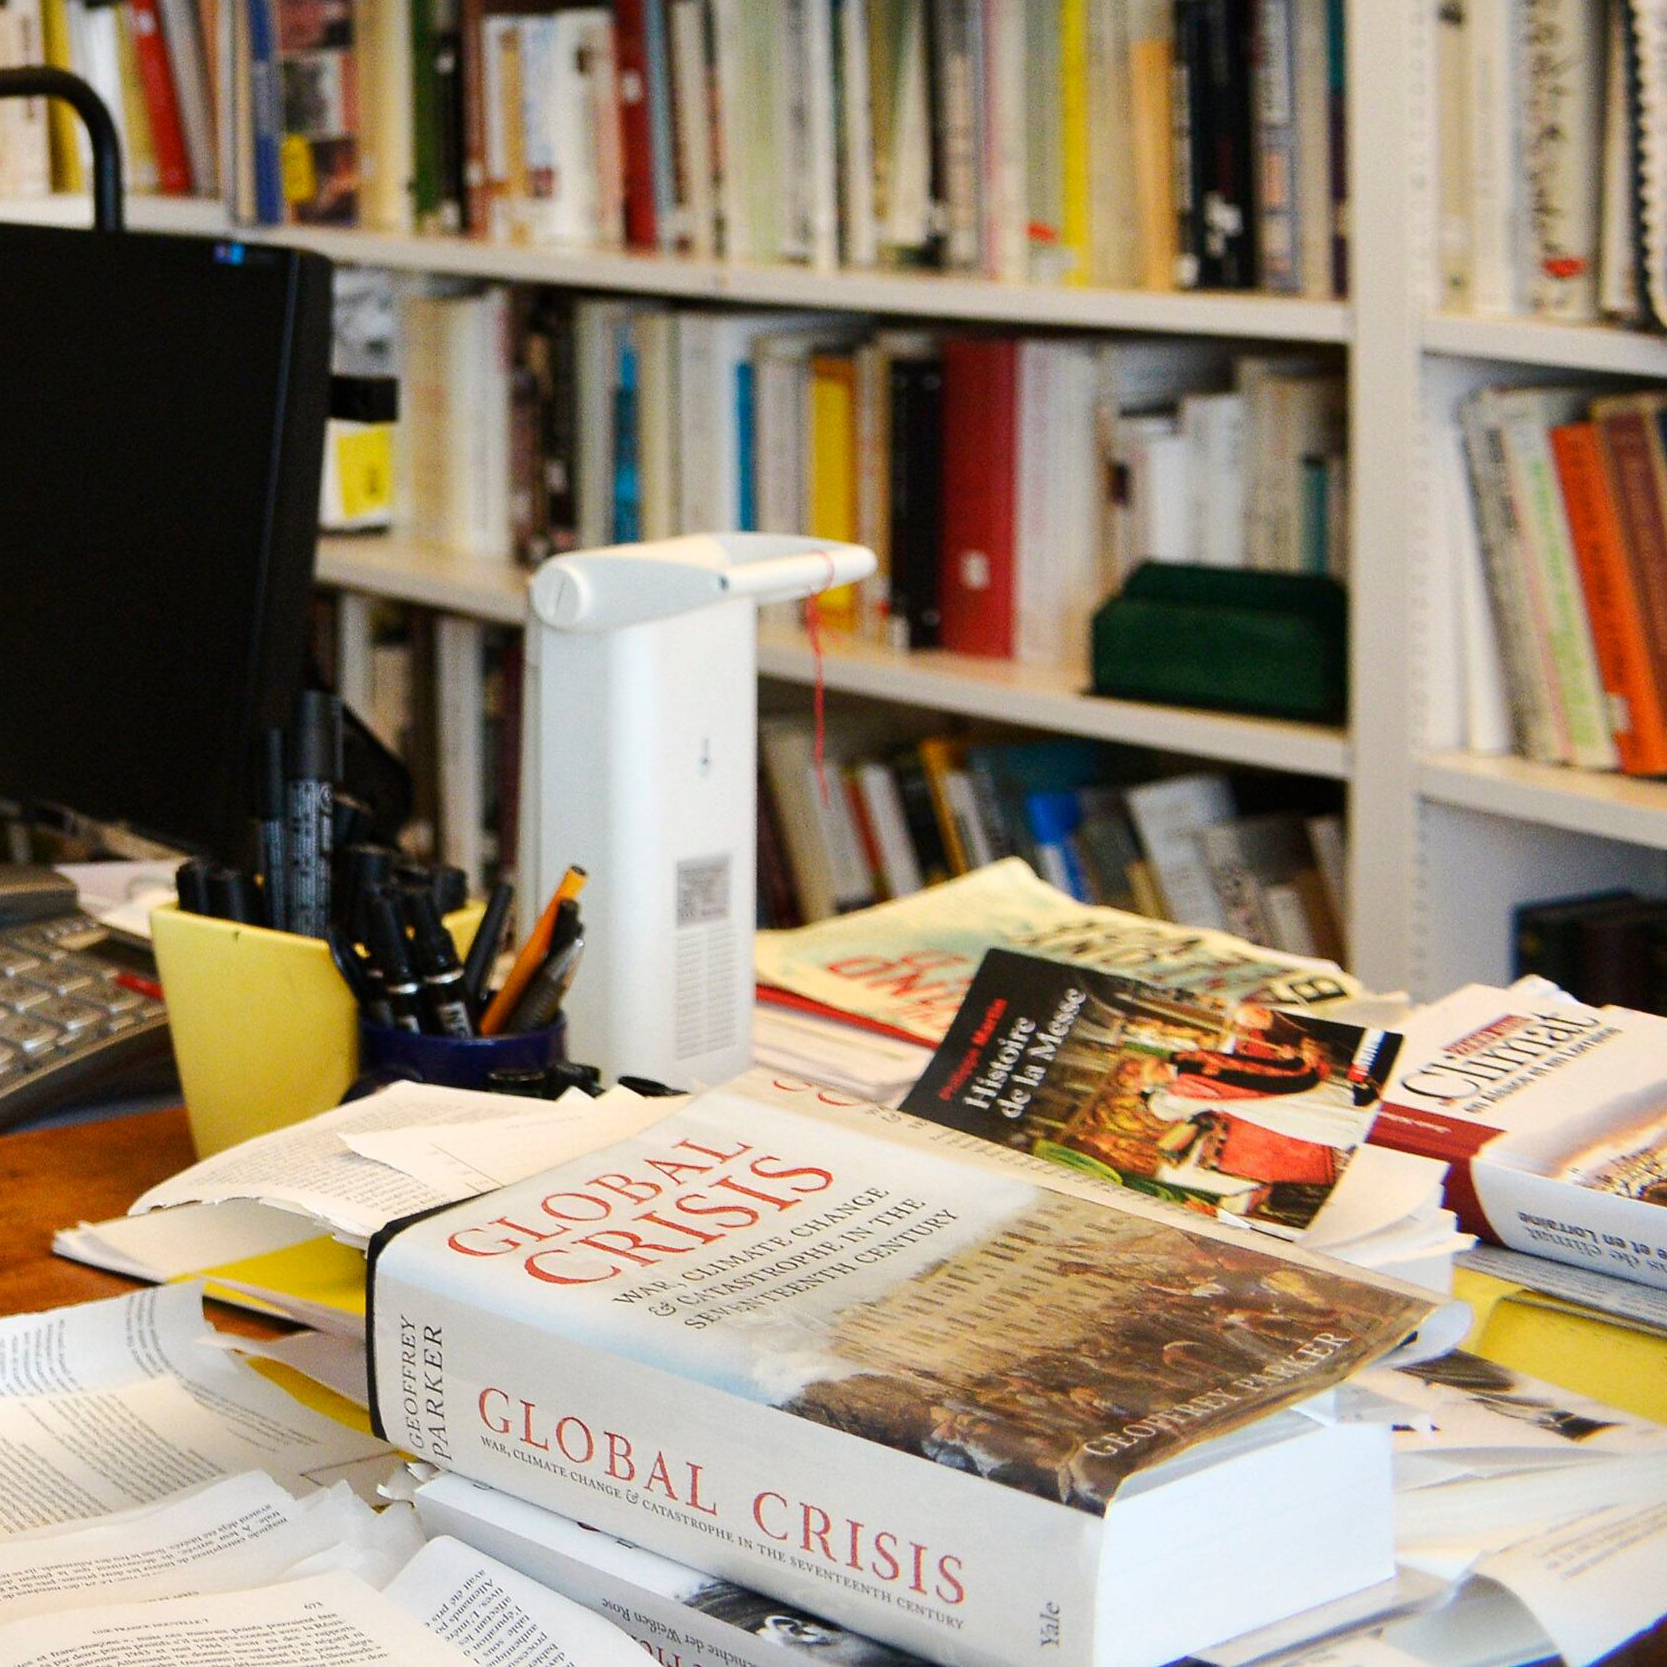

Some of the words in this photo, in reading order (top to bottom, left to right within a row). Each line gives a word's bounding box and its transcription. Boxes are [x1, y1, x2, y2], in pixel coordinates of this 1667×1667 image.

[964, 1015, 1038, 1111] Histoire
[1033, 987, 1087, 1064] Messe
[1401, 1011, 1600, 1100] Climat
[1001, 1085, 1032, 1120] de
[1022, 1061, 1048, 1089] la
[446, 1136, 755, 1257] GLOBAL
[523, 1154, 834, 1285] CRISIS
[1517, 1211, 1598, 1244] Lorraine
[1601, 1233, 1626, 1249] en
[613, 1277, 684, 1307] WAR,
[681, 1233, 795, 1283] CLIMATE
[789, 1185, 891, 1240] CHANGE
[676, 1240, 844, 1310] CATASTROPHE
[837, 1226, 869, 1254] IN
[867, 1196, 928, 1237] THE
[683, 1261, 855, 1331] SEVENTEENTH
[853, 1207, 960, 1266] CENTURY
[1629, 1240, 1651, 1256] et
[400, 1314, 426, 1450] GEOFFREY
[422, 1324, 453, 1462] PARKER
[1082, 1386, 1244, 1457] GEOFFREY
[1232, 1331, 1353, 1393] PARKER
[477, 1387, 718, 1517] GLOBAL
[752, 1491, 966, 1606] CRISIS
[480, 1435, 513, 1460] WAR,
[512, 1447, 568, 1480] CLIMATE
[569, 1470, 623, 1500] CHANGE
[625, 1488, 641, 1505] &
[641, 1498, 735, 1544] CATASTROPHE
[737, 1535, 754, 1551] IN
[756, 1542, 787, 1563] THE
[789, 1550, 893, 1605] SEVENTEENTH
[896, 1597, 965, 1631] CENTURY
[601, 1597, 631, 1623] Rose
[632, 1612, 682, 1645] Weißen
[683, 1633, 705, 1656] der
[1040, 1600, 1062, 1649] Yale
